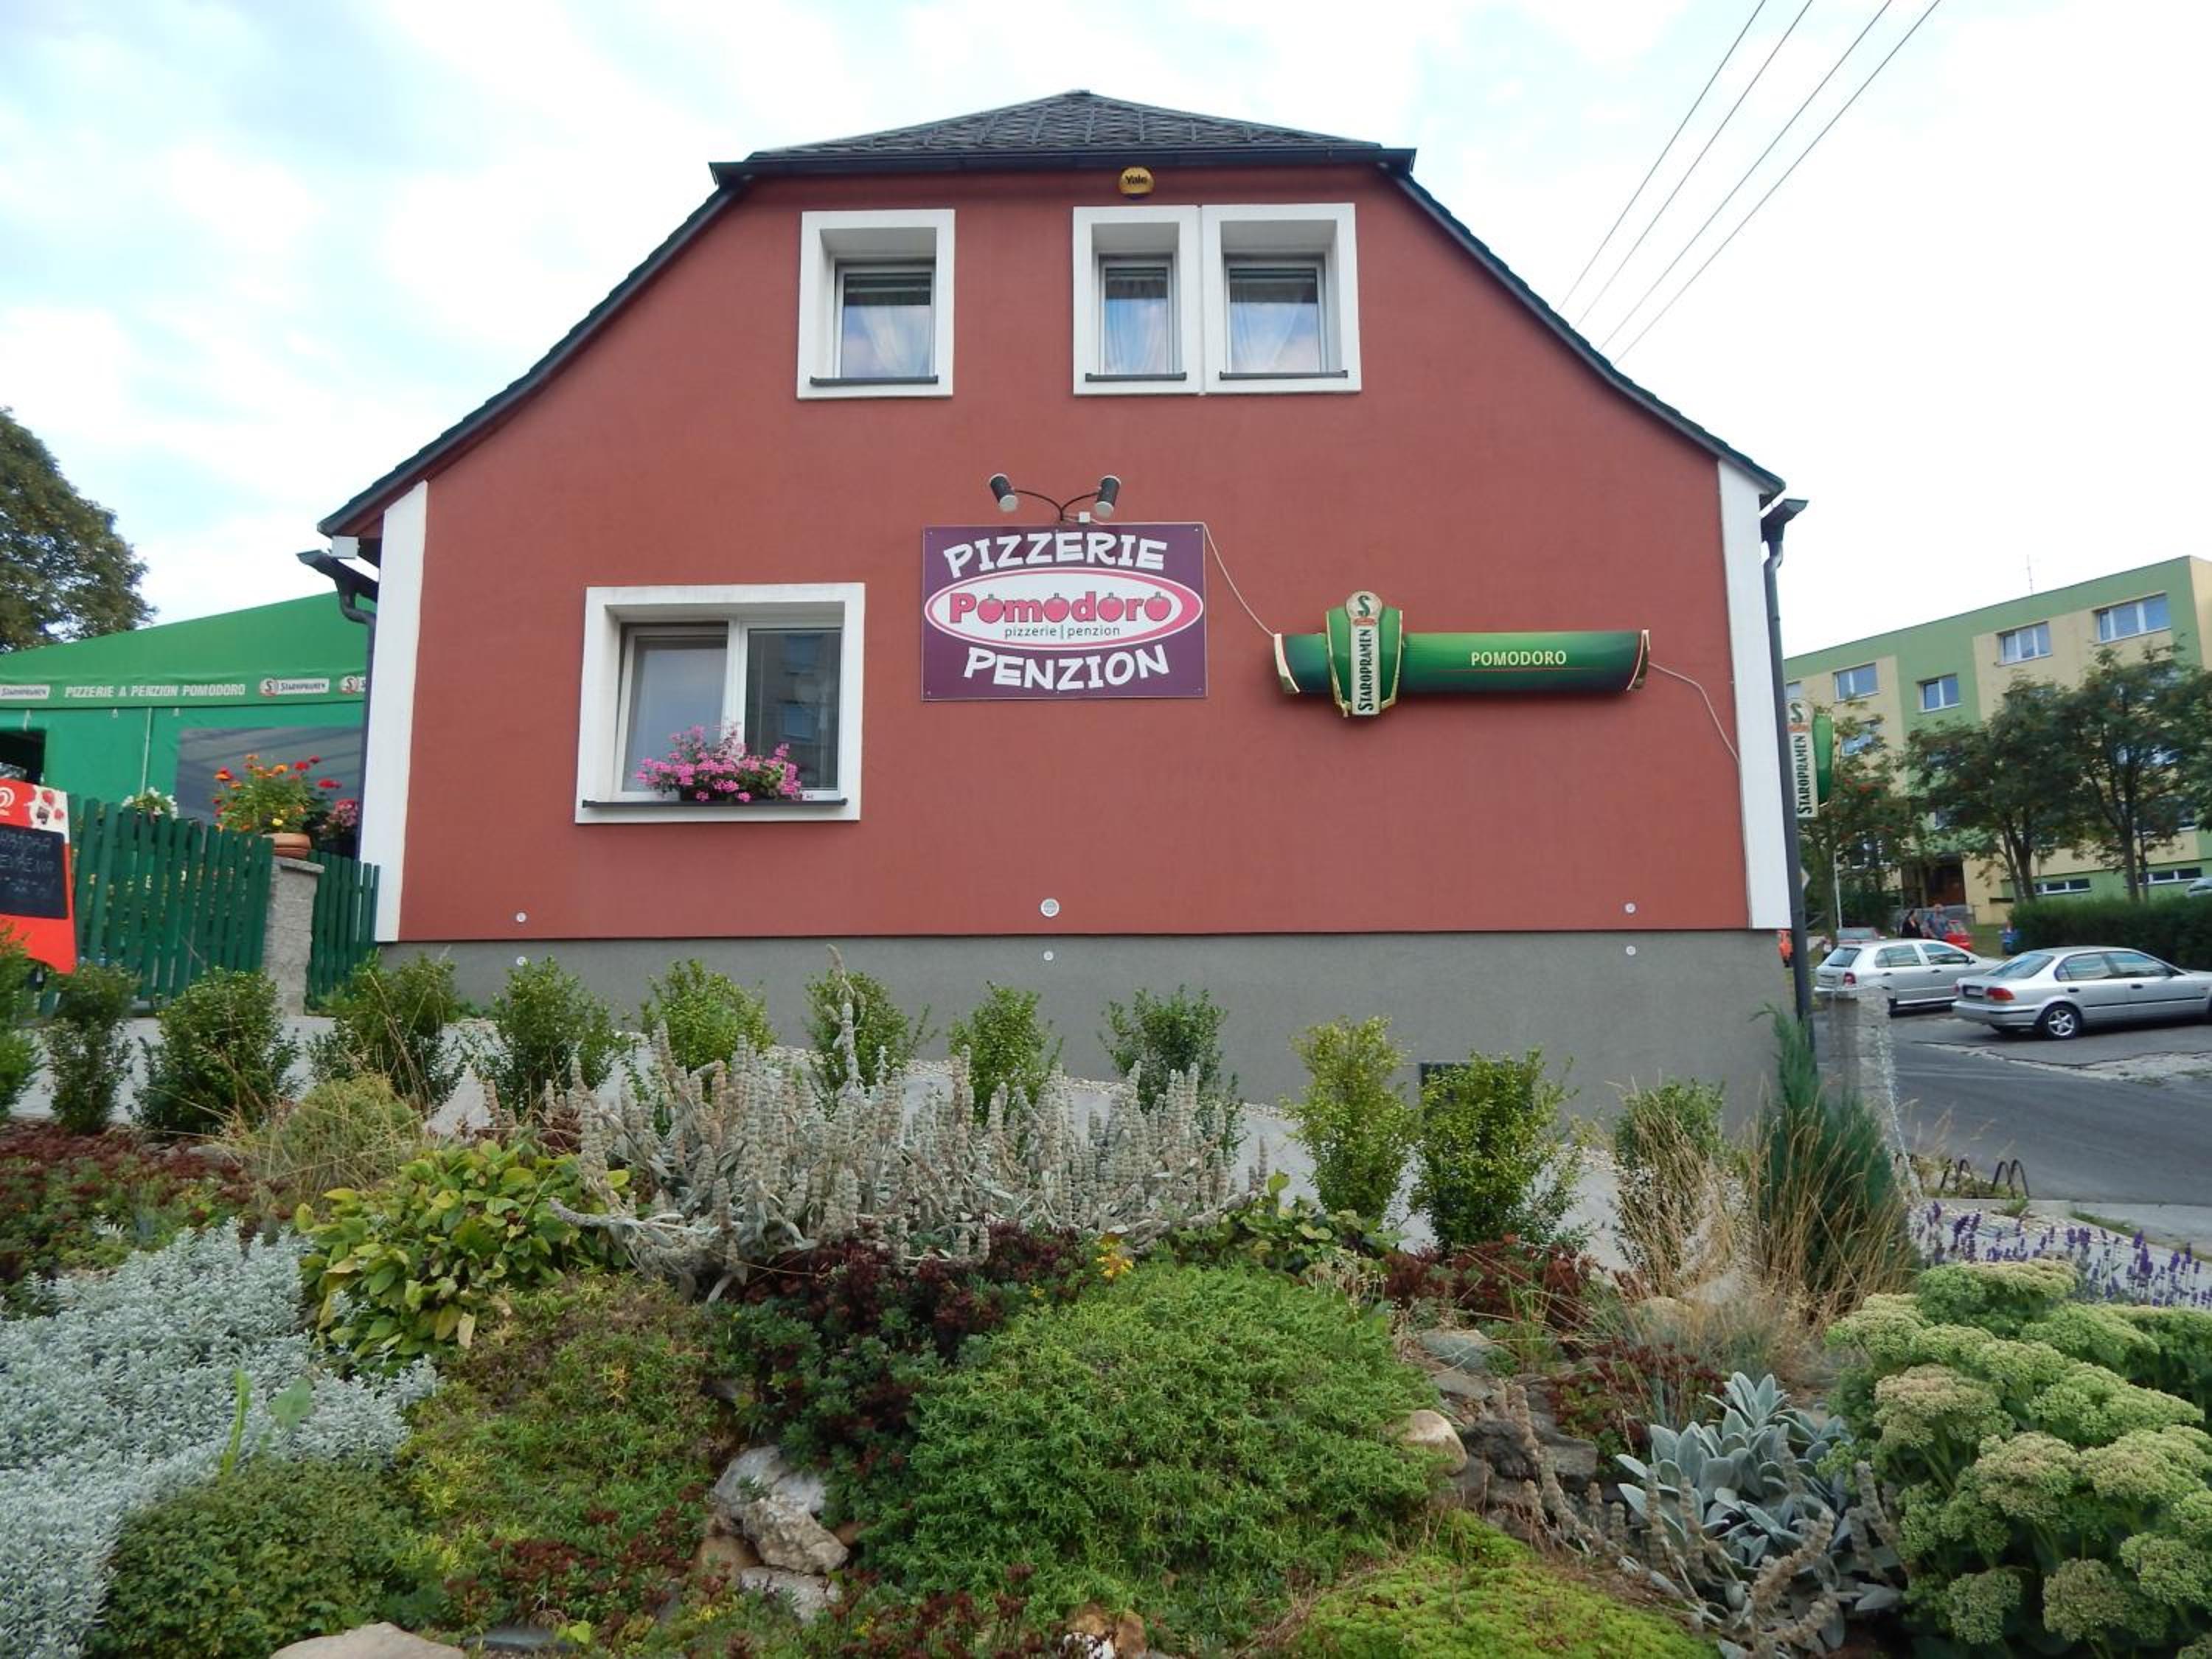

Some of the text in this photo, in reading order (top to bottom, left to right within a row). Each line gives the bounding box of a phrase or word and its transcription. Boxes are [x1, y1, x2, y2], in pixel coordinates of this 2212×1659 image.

[1124, 174, 1148, 184] Yale
[944, 531, 1168, 578] PIZZERIE
[949, 591, 1172, 624] Pomodoro
[1005, 625, 1120, 639] pizzerie penzion
[964, 644, 1169, 691] PENZION
[1358, 629, 1374, 711] STAROPRAMEN
[1471, 650, 1567, 666] POMODORO
[64, 686, 114, 698] PIZZERIE
[131, 685, 178, 697] PENZION
[183, 684, 246, 696] POMODORO
[1793, 736, 1813, 814] STAROPRAMEN
